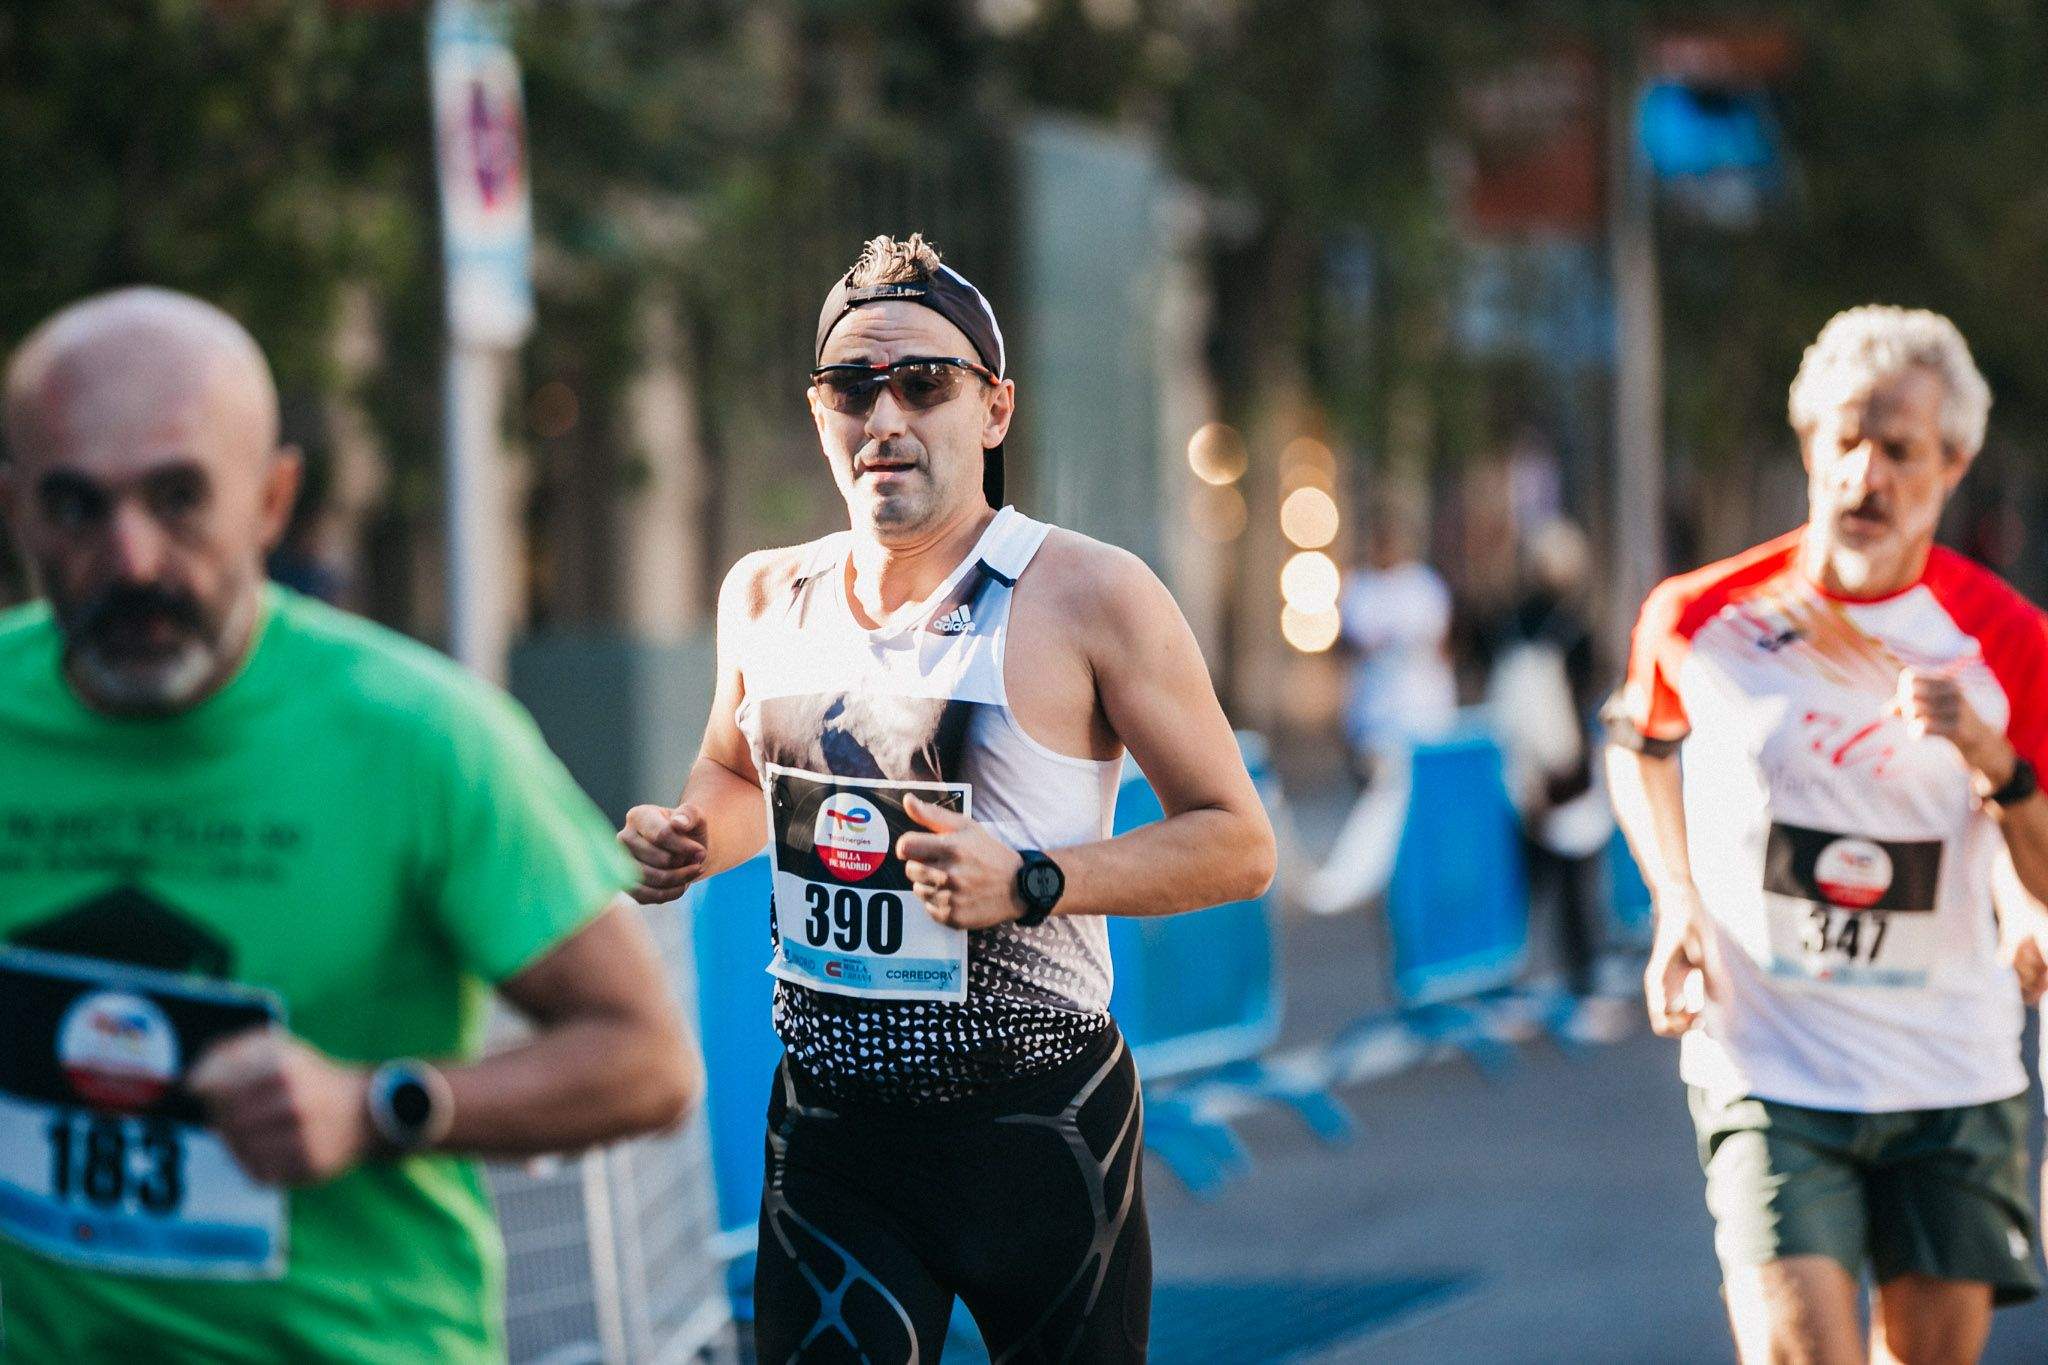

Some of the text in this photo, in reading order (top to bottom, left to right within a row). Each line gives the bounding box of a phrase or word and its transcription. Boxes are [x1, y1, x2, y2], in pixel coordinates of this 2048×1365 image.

[828, 833, 871, 846] TalEnergies
[837, 850, 861, 861] MILLA
[839, 860, 872, 872] MADRID
[805, 883, 903, 955] 390
[1805, 908, 1888, 963] 347
[49, 1114, 183, 1216] 183
